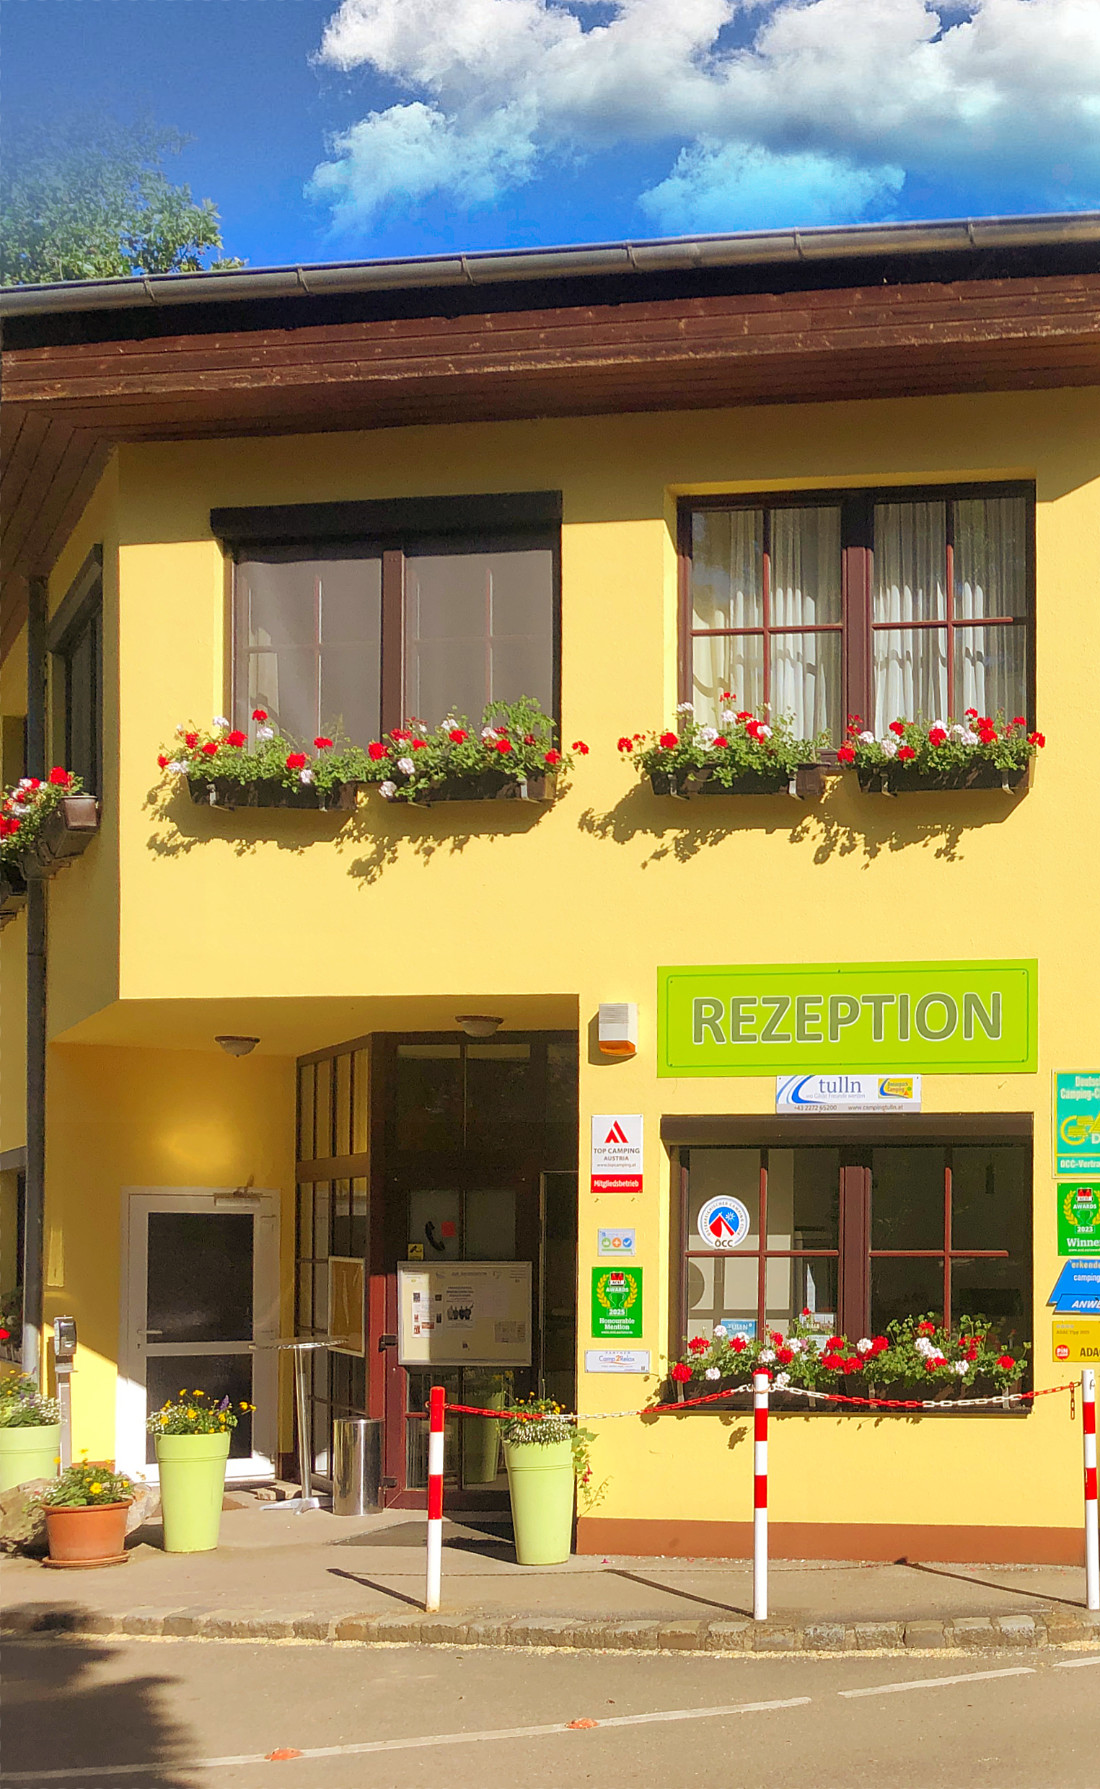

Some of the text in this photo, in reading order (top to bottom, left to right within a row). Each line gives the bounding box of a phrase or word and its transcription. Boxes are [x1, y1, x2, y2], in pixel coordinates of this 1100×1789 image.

[692, 992, 1002, 1044] REZEPTION
[819, 1076, 862, 1093] tulln
[593, 1179, 639, 1188] Mitgliedsbetrieb
[714, 1238, 733, 1248] ÖCC
[1073, 1272, 1100, 1284] camping
